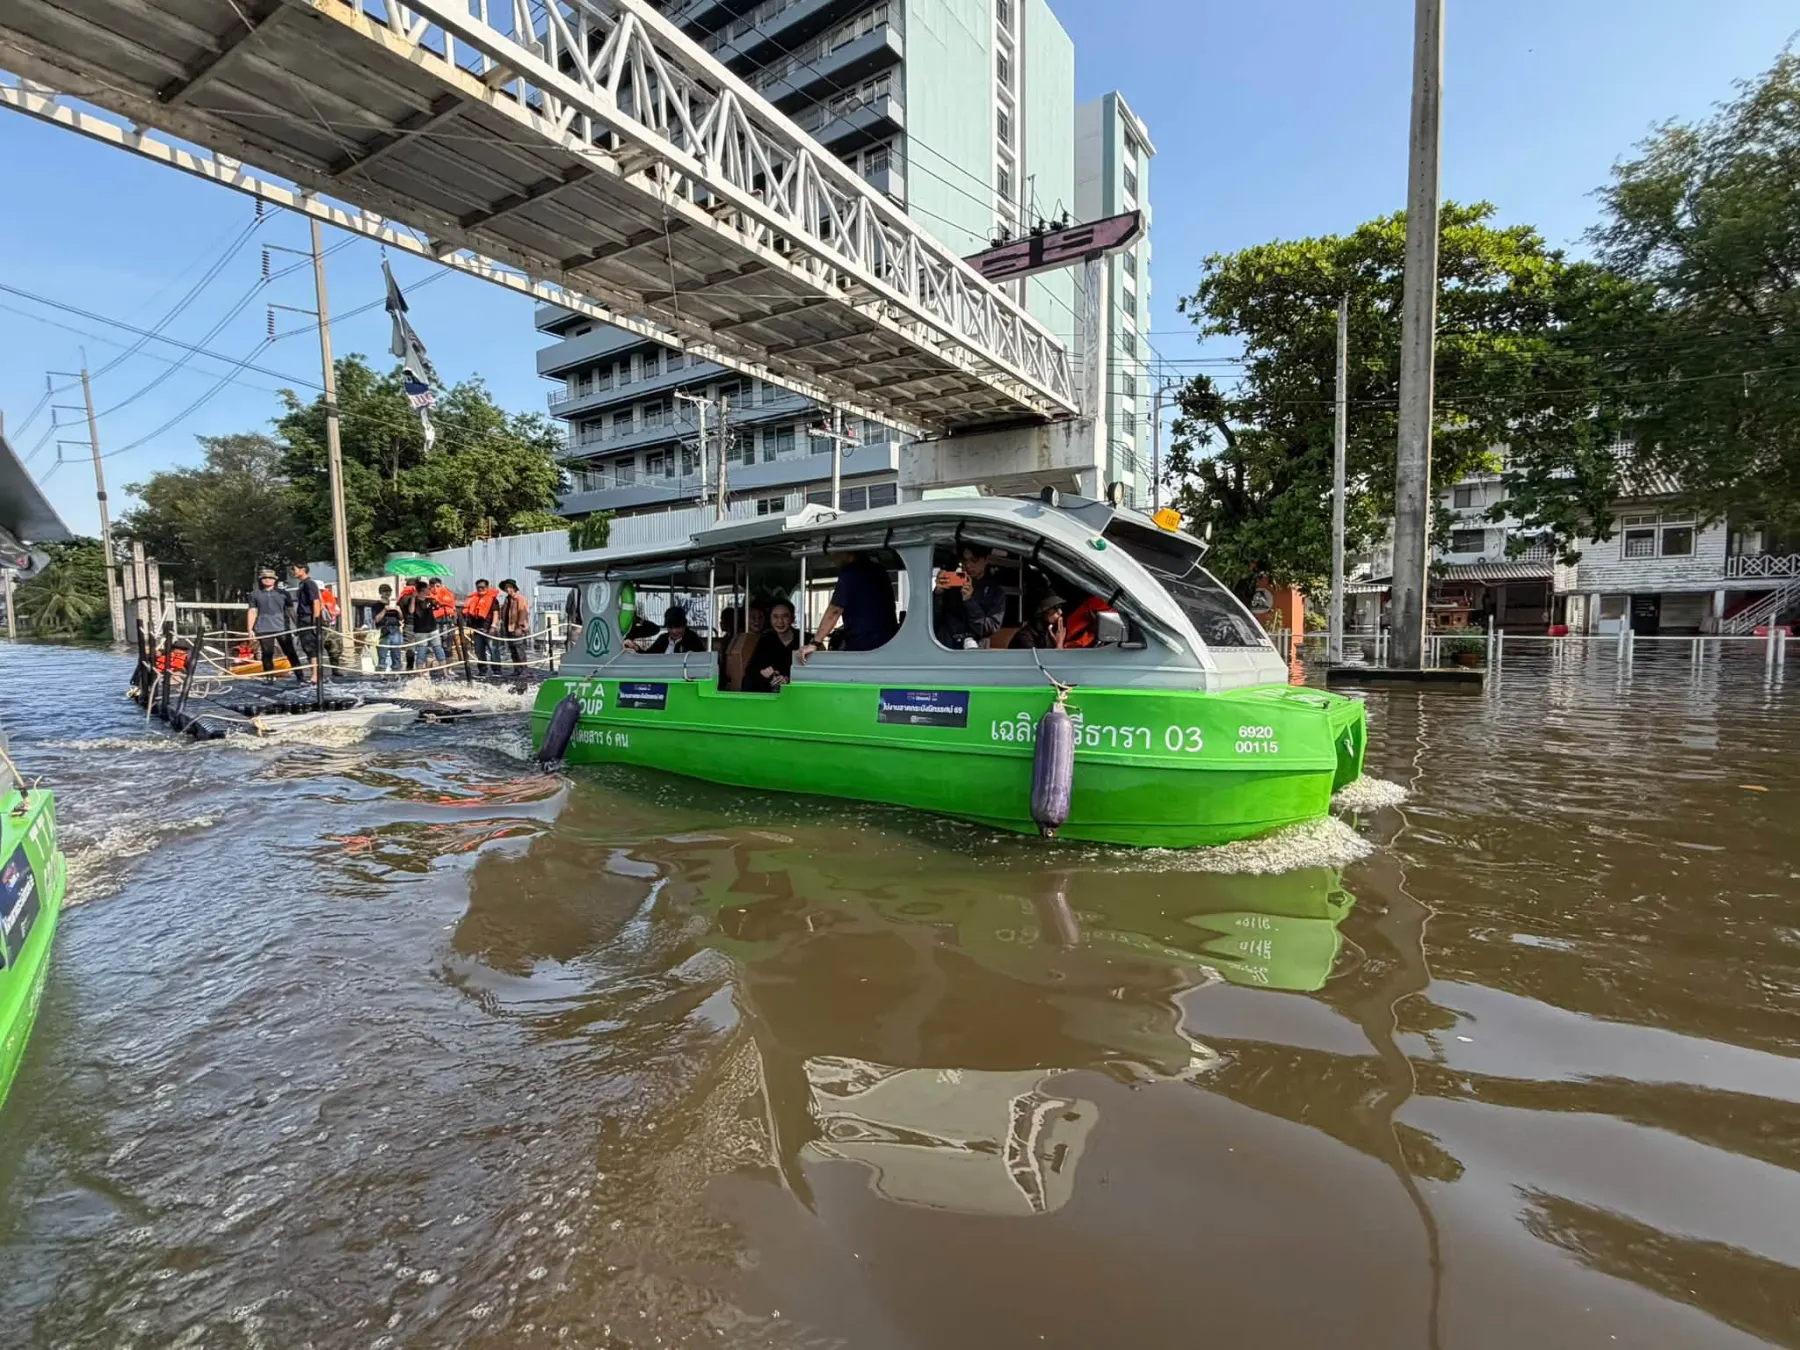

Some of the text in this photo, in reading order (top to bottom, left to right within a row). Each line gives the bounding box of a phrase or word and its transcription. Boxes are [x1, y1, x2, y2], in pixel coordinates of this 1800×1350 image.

[579, 698, 604, 715] OUP
[606, 730, 612, 746] 6
[991, 711, 1204, 752] เฉลิรีธารา 03
[1238, 725, 1274, 739] 6920
[1235, 740, 1279, 753] 00115
